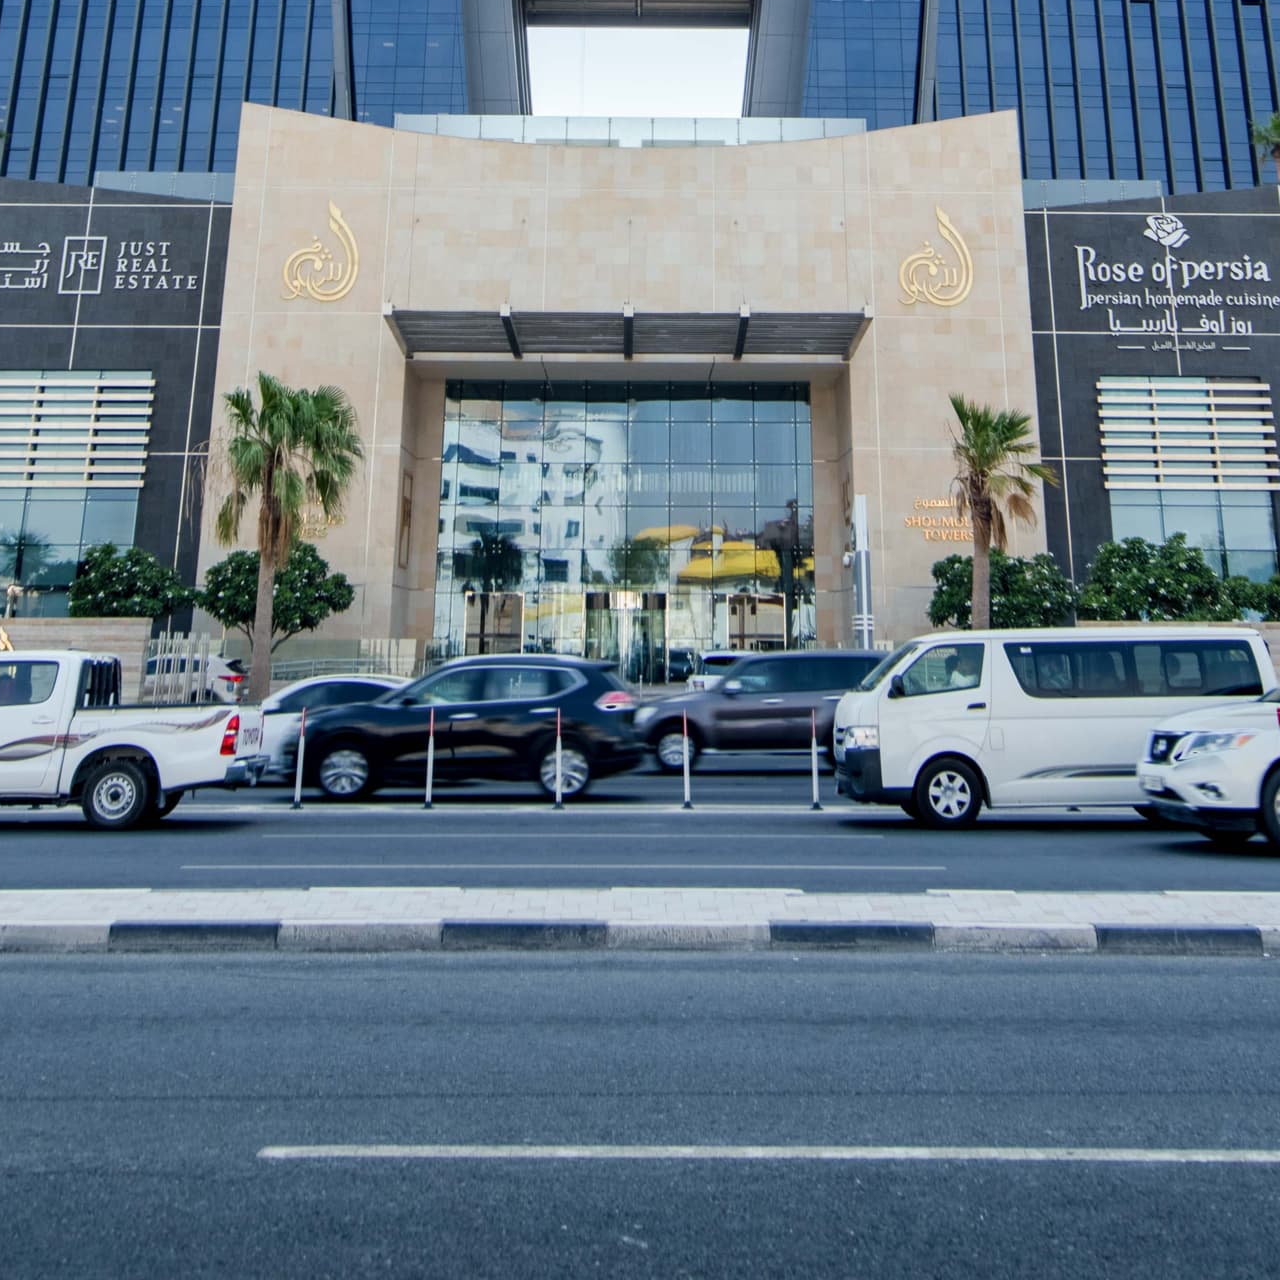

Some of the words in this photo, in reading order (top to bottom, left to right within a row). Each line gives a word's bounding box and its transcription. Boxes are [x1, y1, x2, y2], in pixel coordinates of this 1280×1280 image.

[118, 241, 171, 257] JUST
[116, 258, 171, 273] REAL
[114, 275, 199, 290] ESTATE
[1073, 245, 1144, 310] Rose
[1151, 255, 1178, 288] of
[1179, 254, 1271, 288] persia
[1087, 292, 1143, 309] persian
[1144, 288, 1222, 309] homemade
[1225, 293, 1280, 309] cuisine
[1231, 317, 1253, 335] روز
